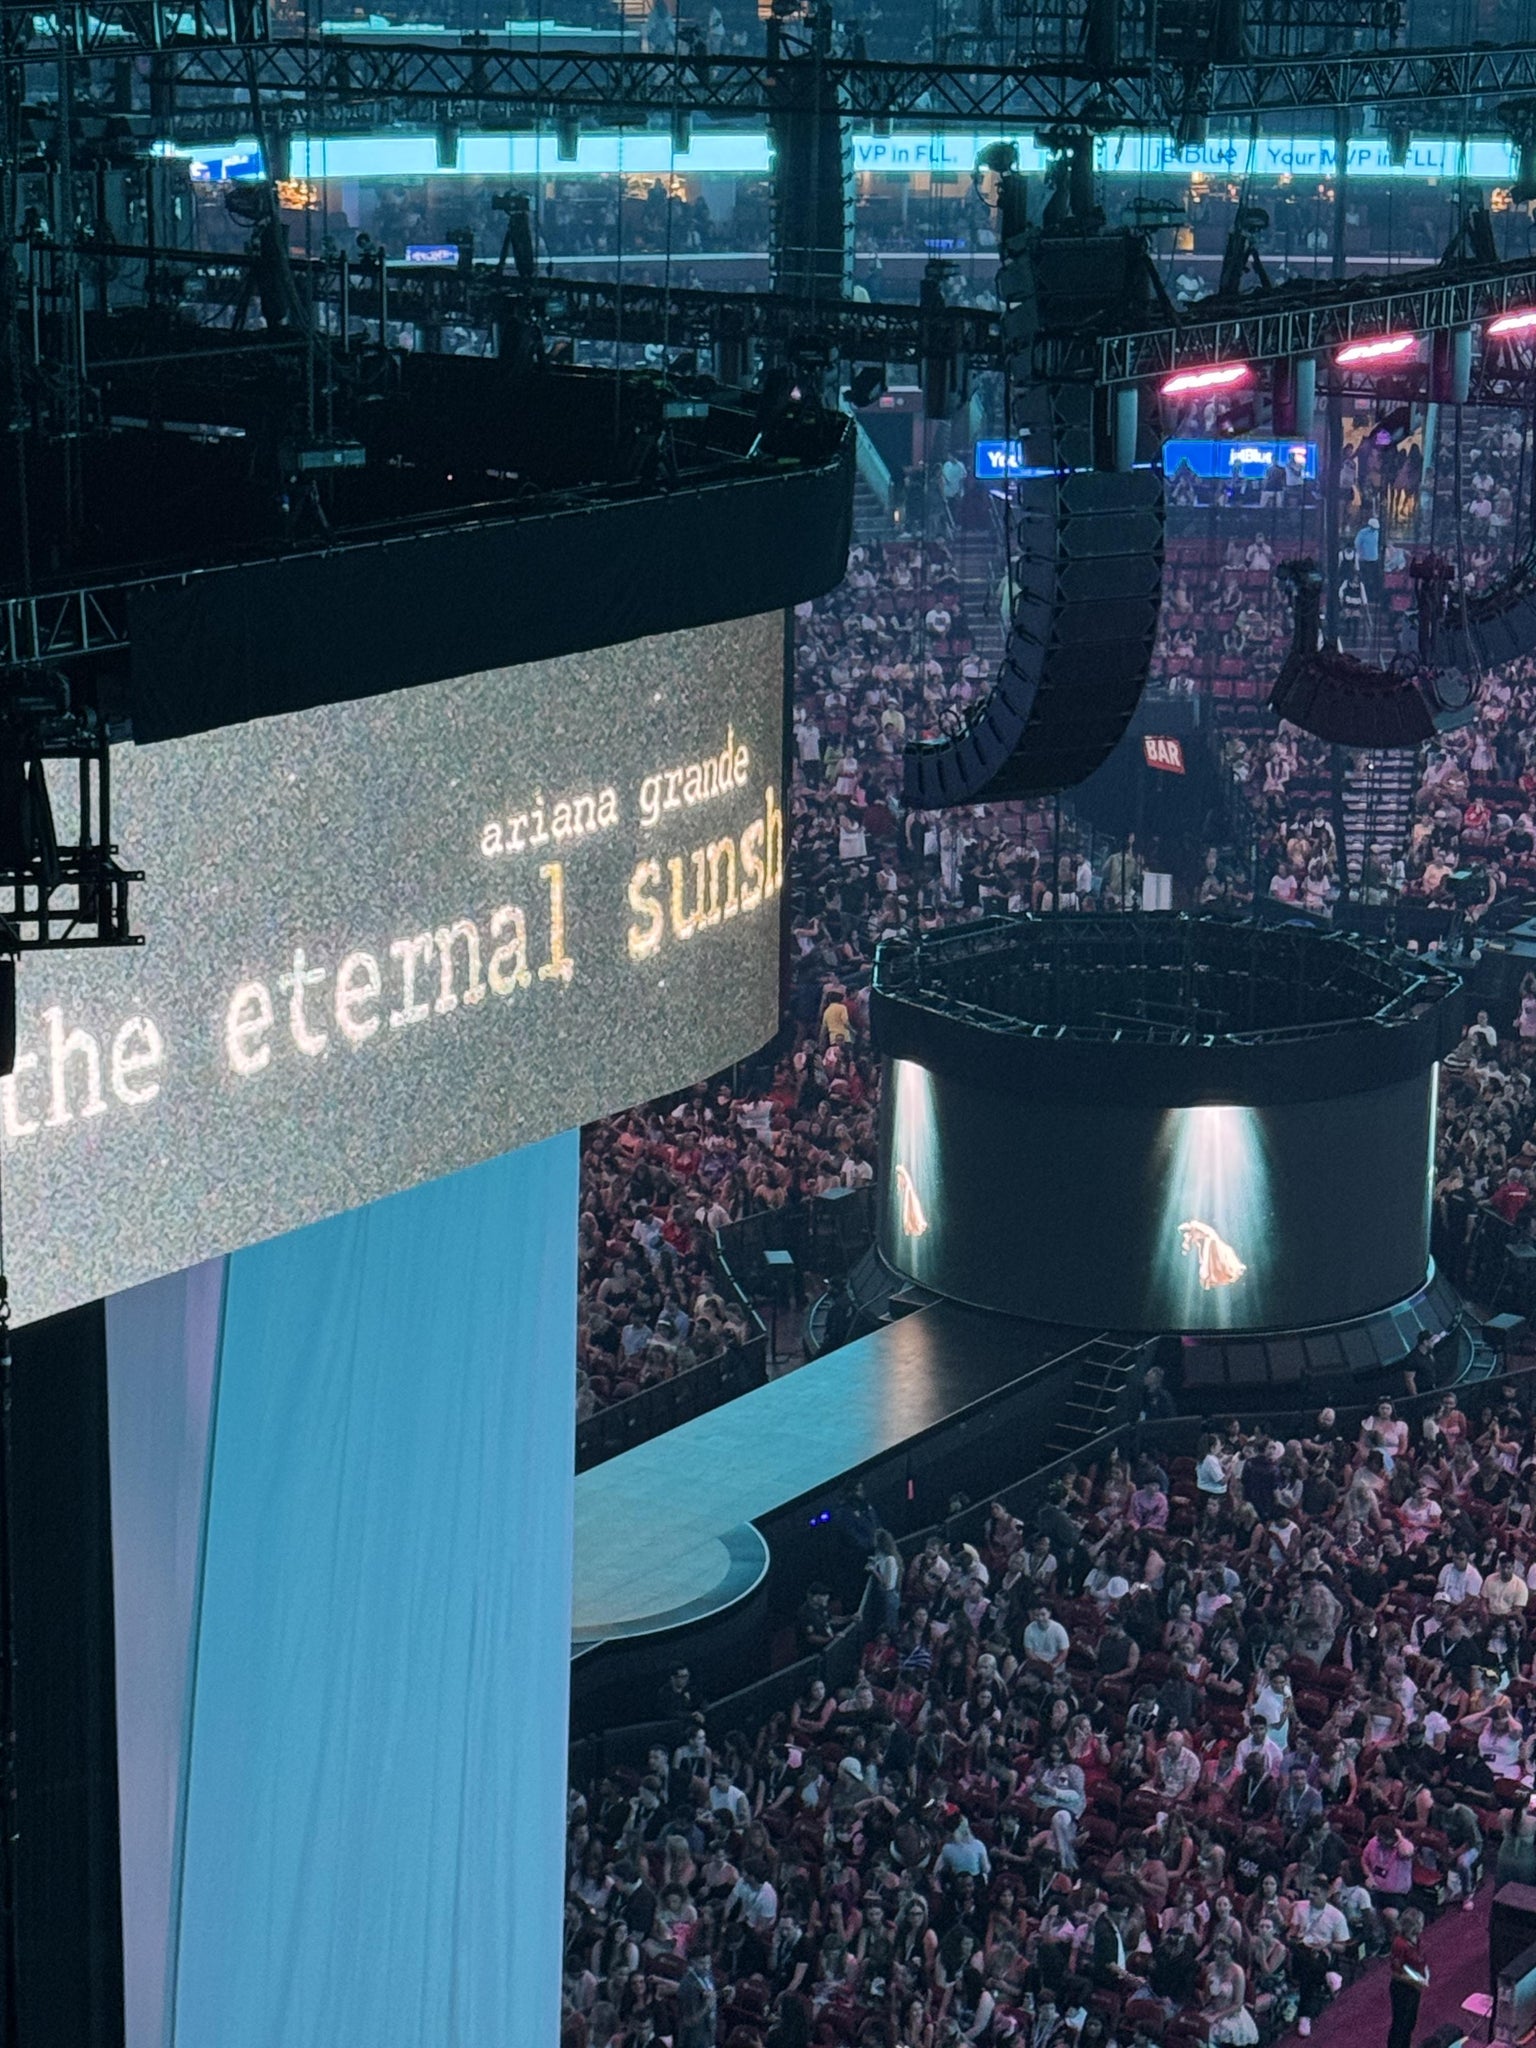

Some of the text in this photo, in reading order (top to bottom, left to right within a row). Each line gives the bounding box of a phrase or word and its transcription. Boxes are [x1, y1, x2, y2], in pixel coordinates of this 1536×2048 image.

[859, 146, 886, 161] VP
[892, 145, 908, 161] in
[1267, 149, 1316, 166] Your
[1145, 739, 1182, 768] BAR
[479, 723, 750, 858] ariana grande
[0, 1005, 165, 1137] the
[224, 859, 575, 1076] eternal
